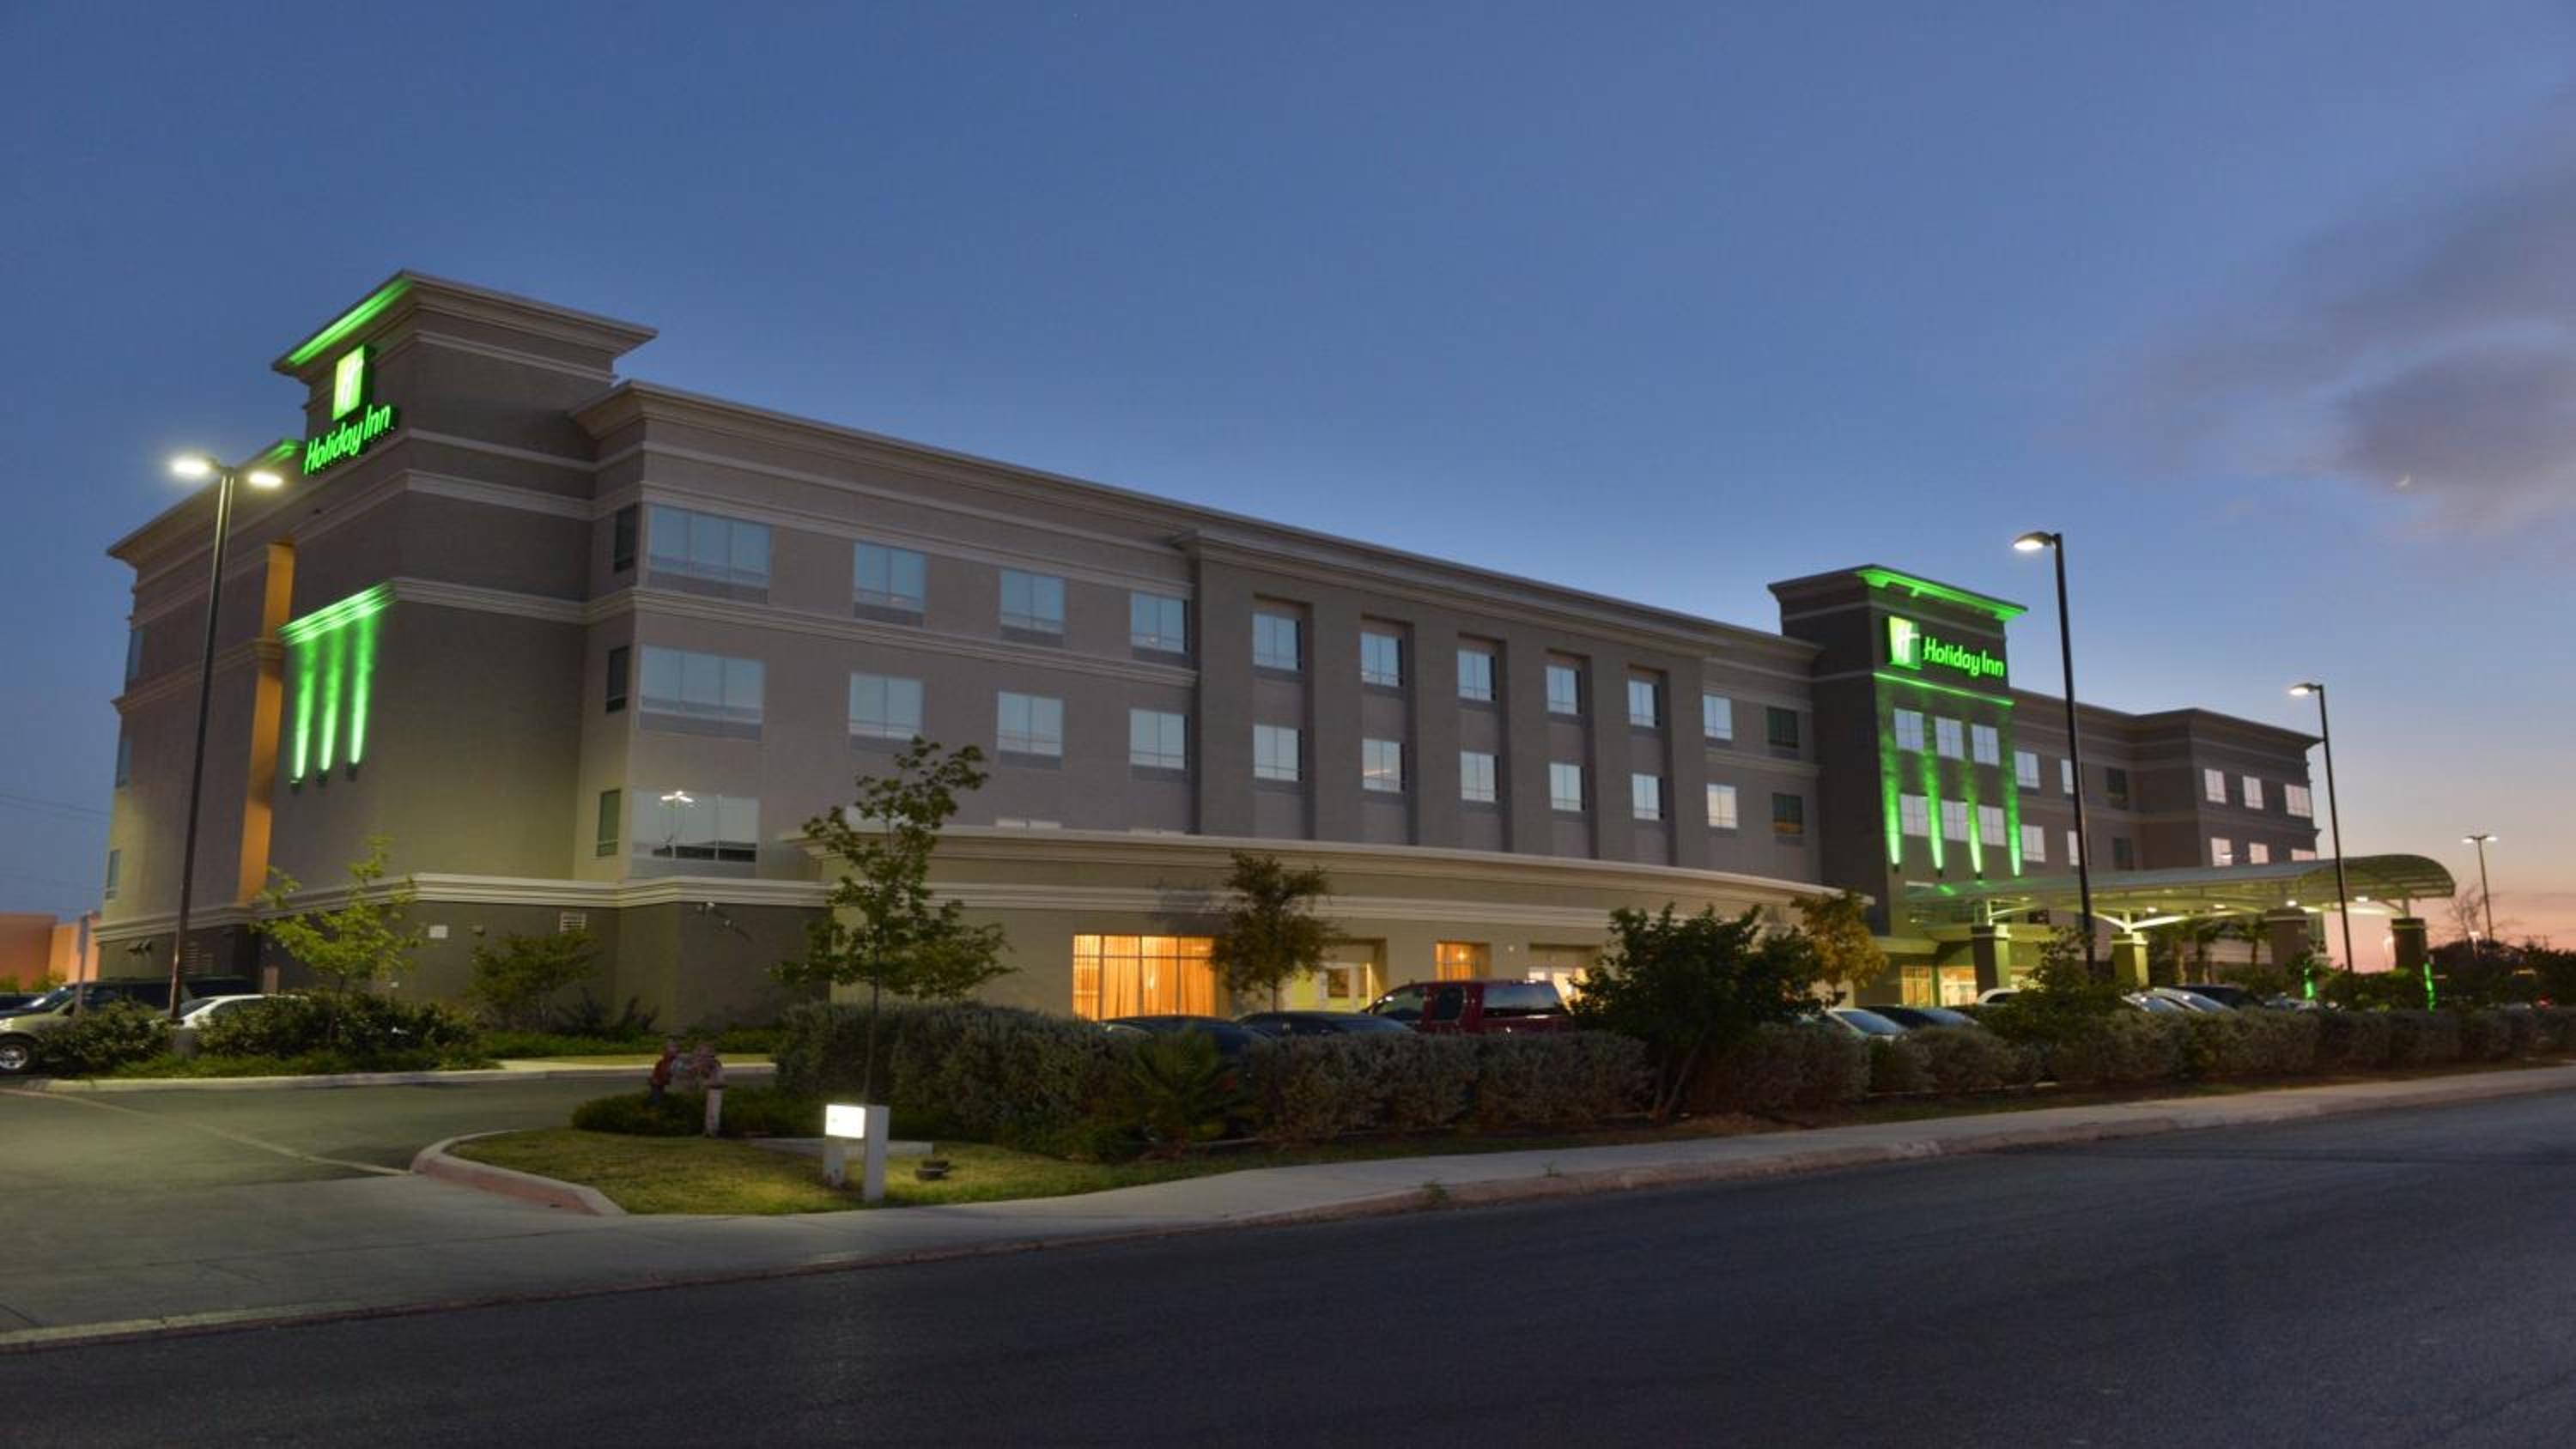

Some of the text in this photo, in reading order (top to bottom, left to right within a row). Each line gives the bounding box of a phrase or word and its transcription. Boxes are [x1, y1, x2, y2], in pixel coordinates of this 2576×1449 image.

[303, 404, 392, 475] Holiday Inn
[1923, 636, 2005, 677] Holiday Inn
